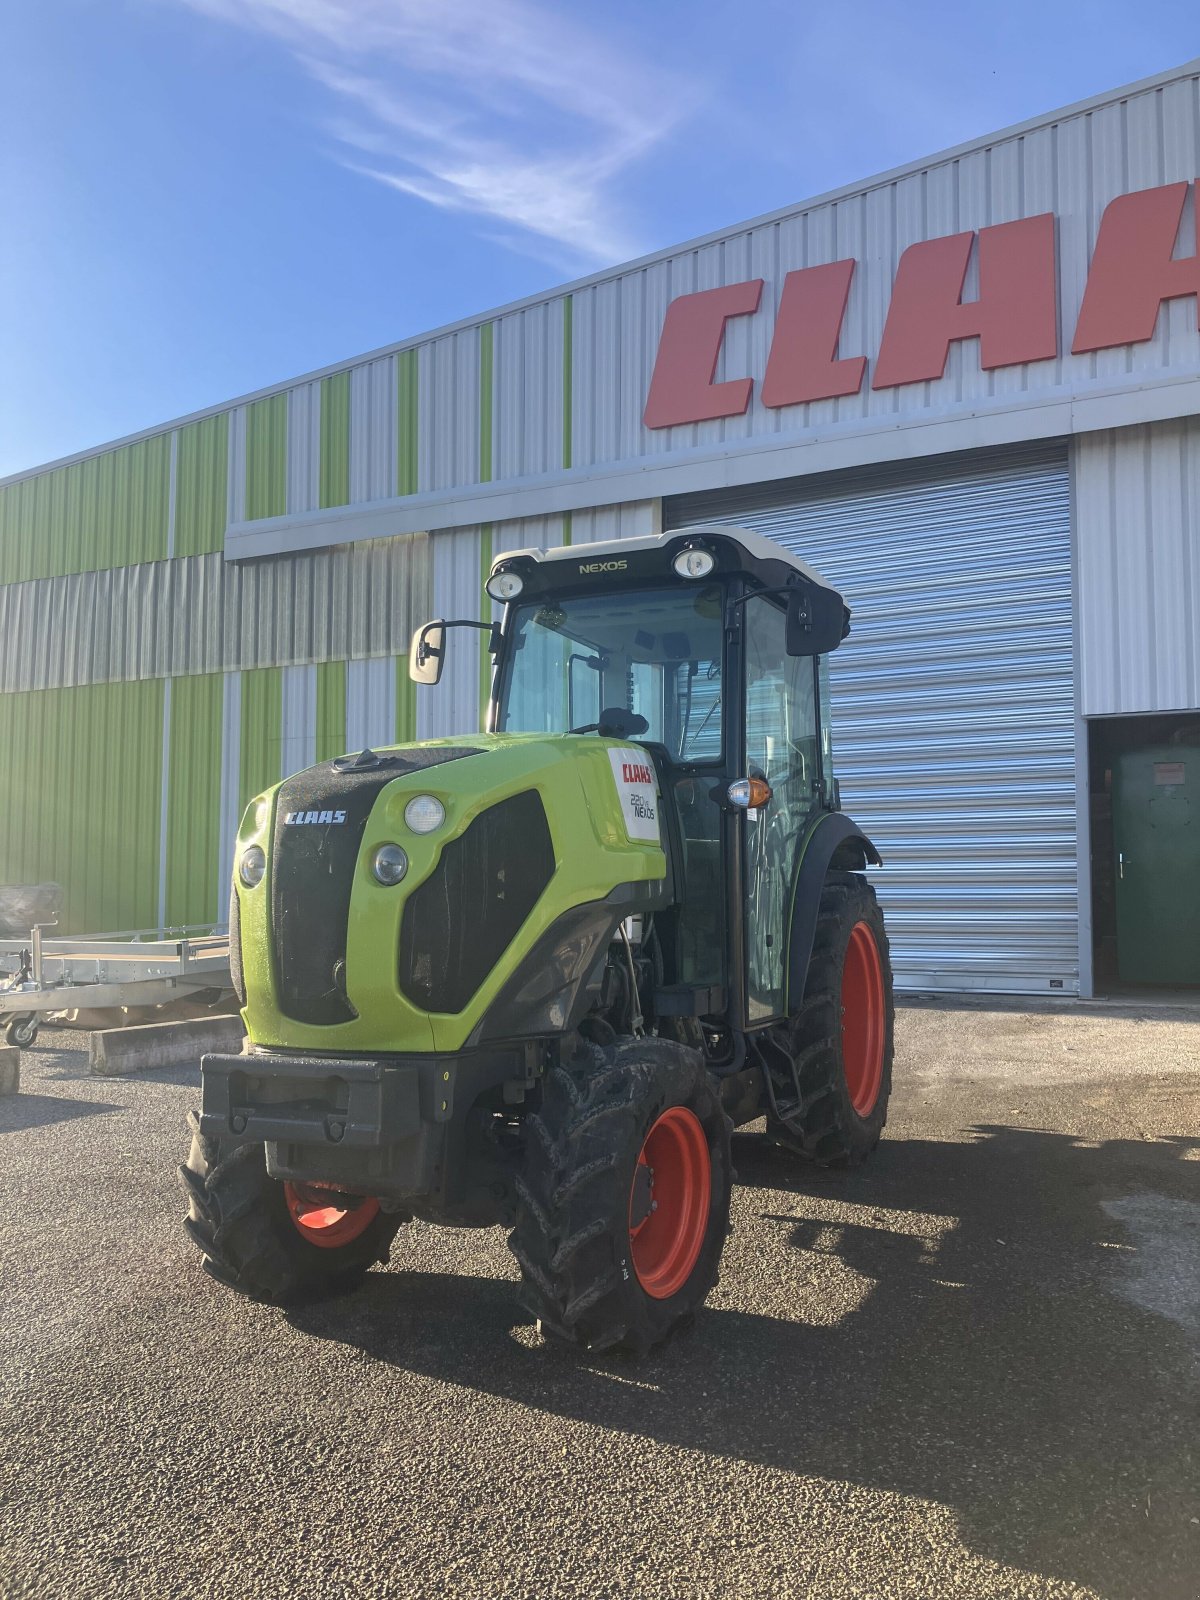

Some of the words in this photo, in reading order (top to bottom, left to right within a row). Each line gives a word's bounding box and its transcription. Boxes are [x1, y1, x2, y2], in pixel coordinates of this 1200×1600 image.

[579, 560, 628, 574] NEXOS
[622, 764, 652, 784] CLAAS
[284, 810, 347, 825] CLAAS
[634, 805, 655, 820] NEXOS
